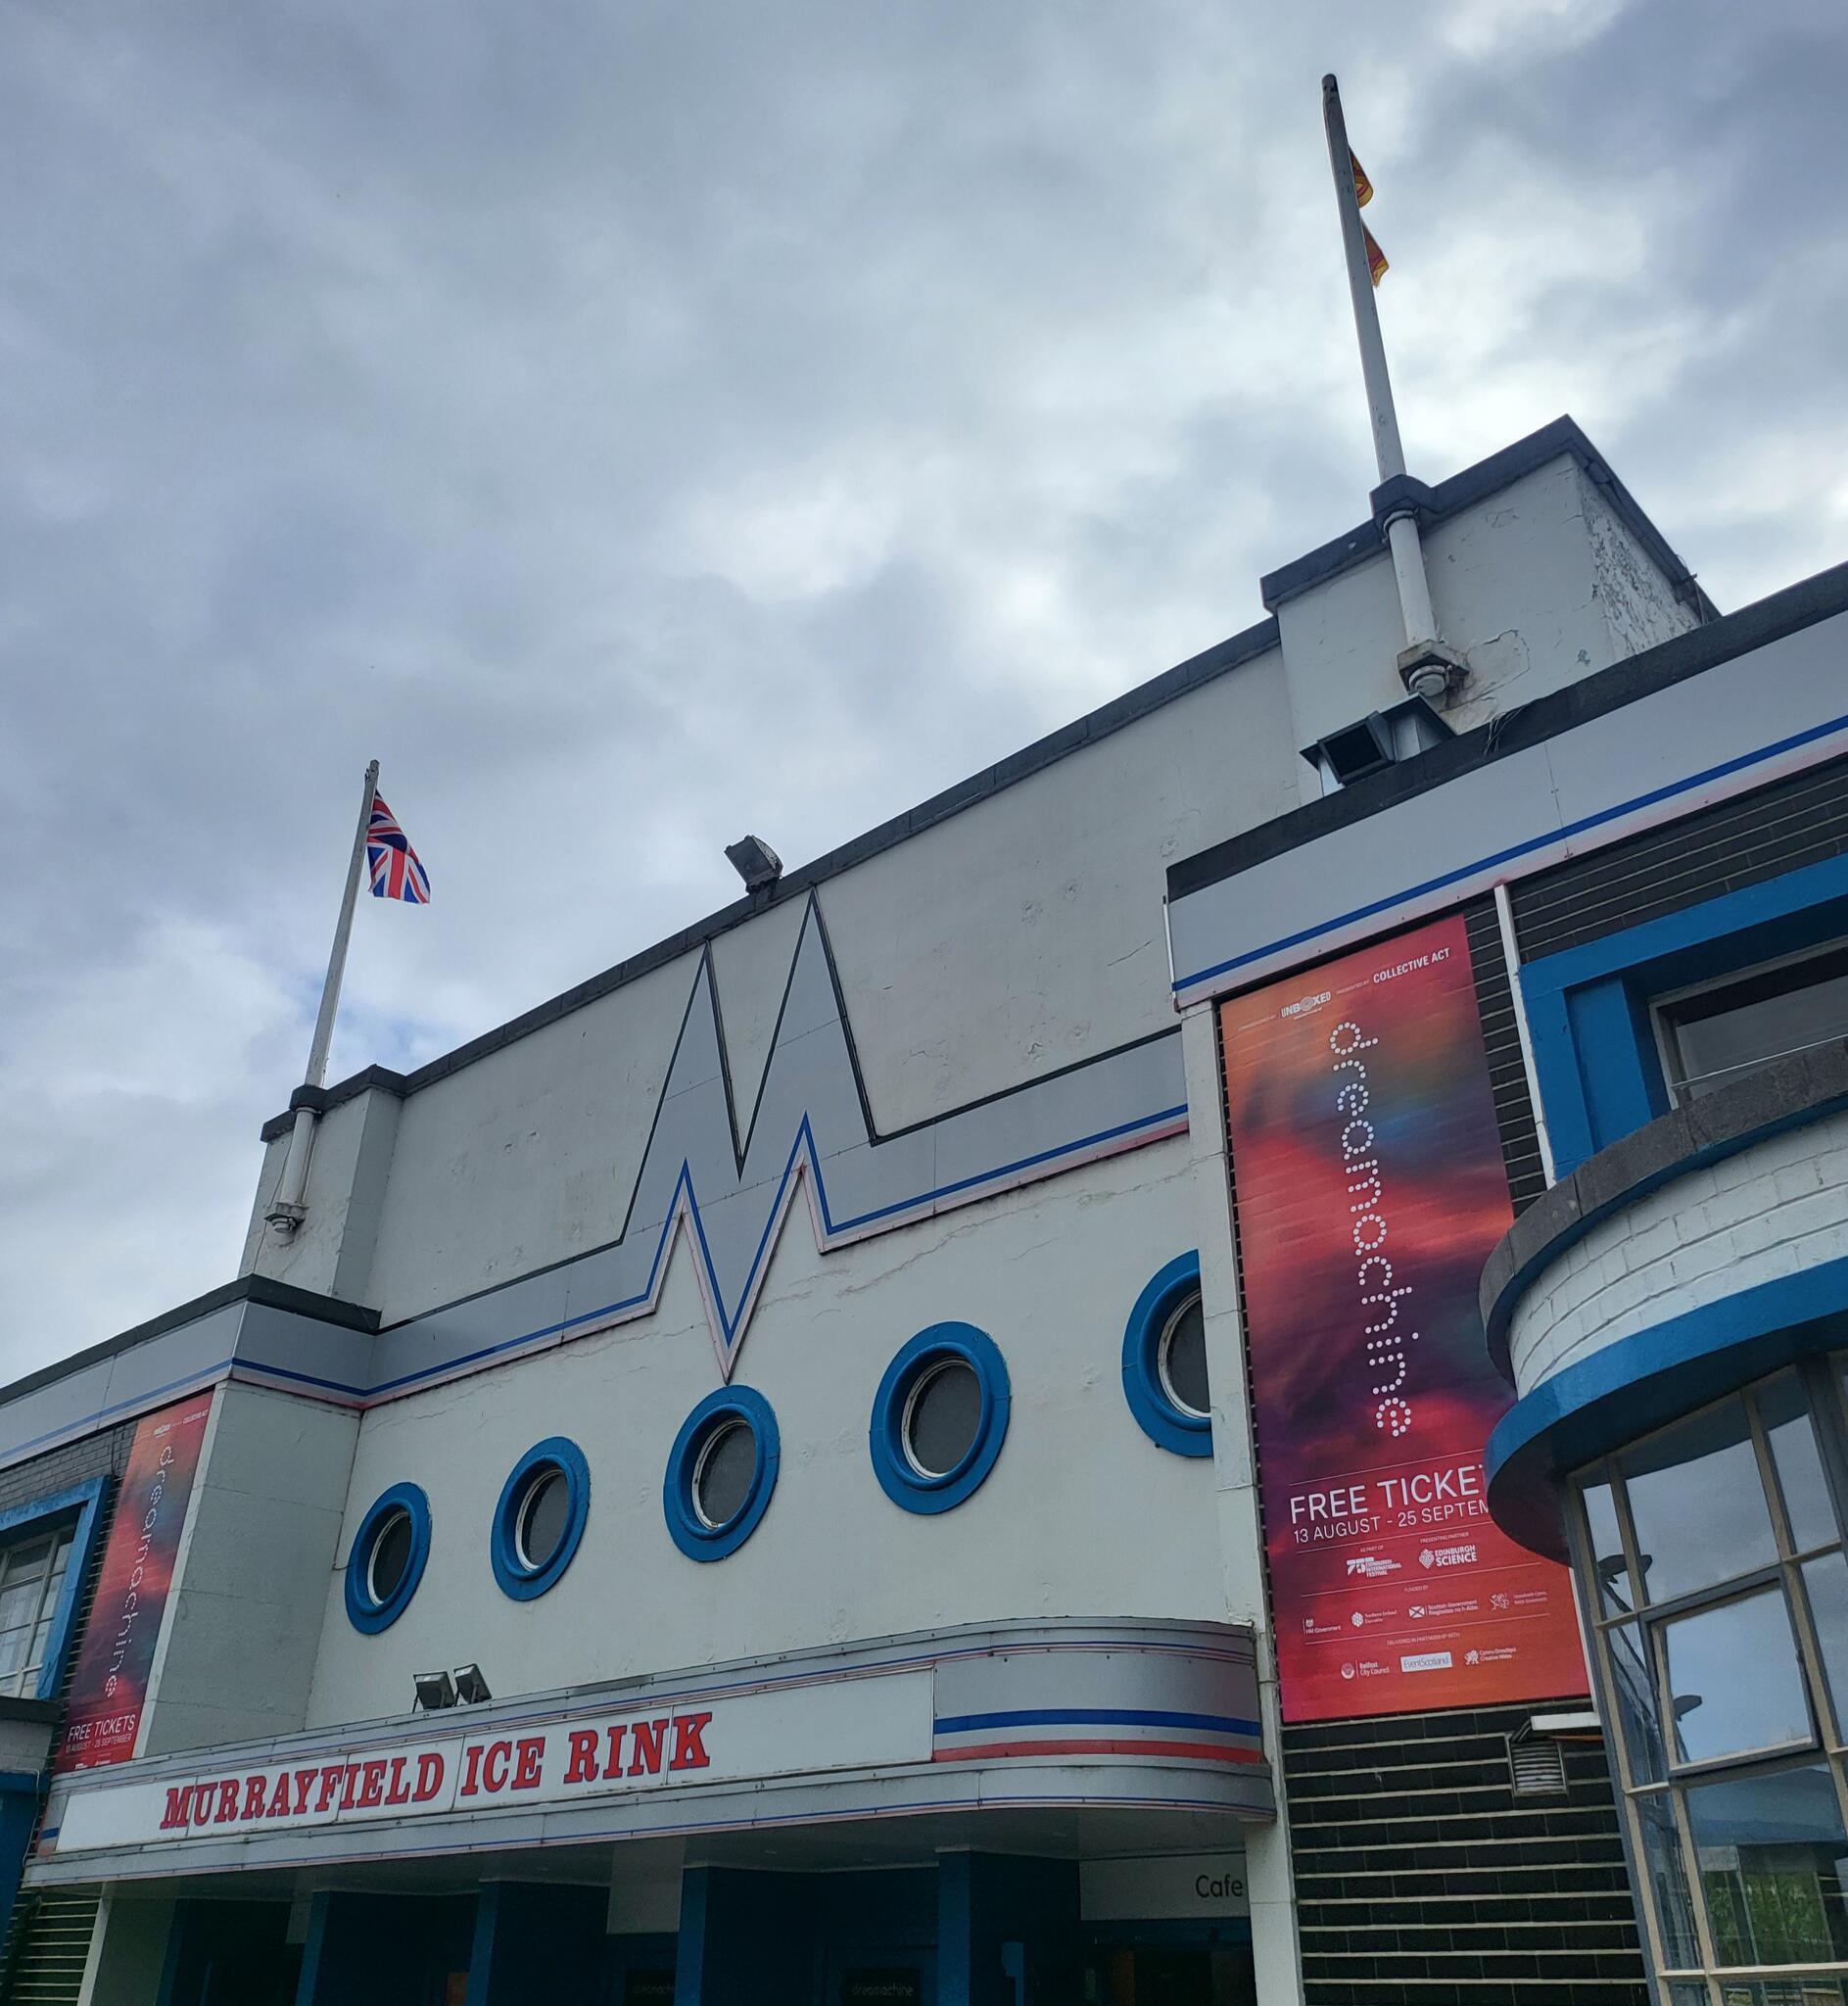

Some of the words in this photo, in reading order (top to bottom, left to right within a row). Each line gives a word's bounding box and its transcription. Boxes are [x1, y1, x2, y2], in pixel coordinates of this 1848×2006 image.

[1373, 956, 1429, 983] COLLECTIVE
[1431, 947, 1450, 964] ACT
[1329, 1022, 1419, 1437] dreamachine
[1289, 1485, 1369, 1525] FREE
[1376, 1464, 1484, 1508] TICKE
[1293, 1528, 1308, 1544] 13
[1313, 1516, 1381, 1541] AUGUST
[1398, 1510, 1417, 1528] 25
[1435, 1545, 1476, 1557] EDINBURGH
[1436, 1552, 1478, 1567] SCIENCE
[105, 1445, 174, 1697] dreamachine
[1359, 1668, 1370, 1677] City
[1370, 1666, 1391, 1675] Council
[68, 1723, 93, 1743] FREE
[94, 1714, 136, 1737] TICKETS
[159, 1753, 446, 1831] MURRAYFIELD
[460, 1737, 545, 1796] ICE
[563, 1711, 713, 1784] RINK
[1195, 1873, 1244, 1898] Cafe
